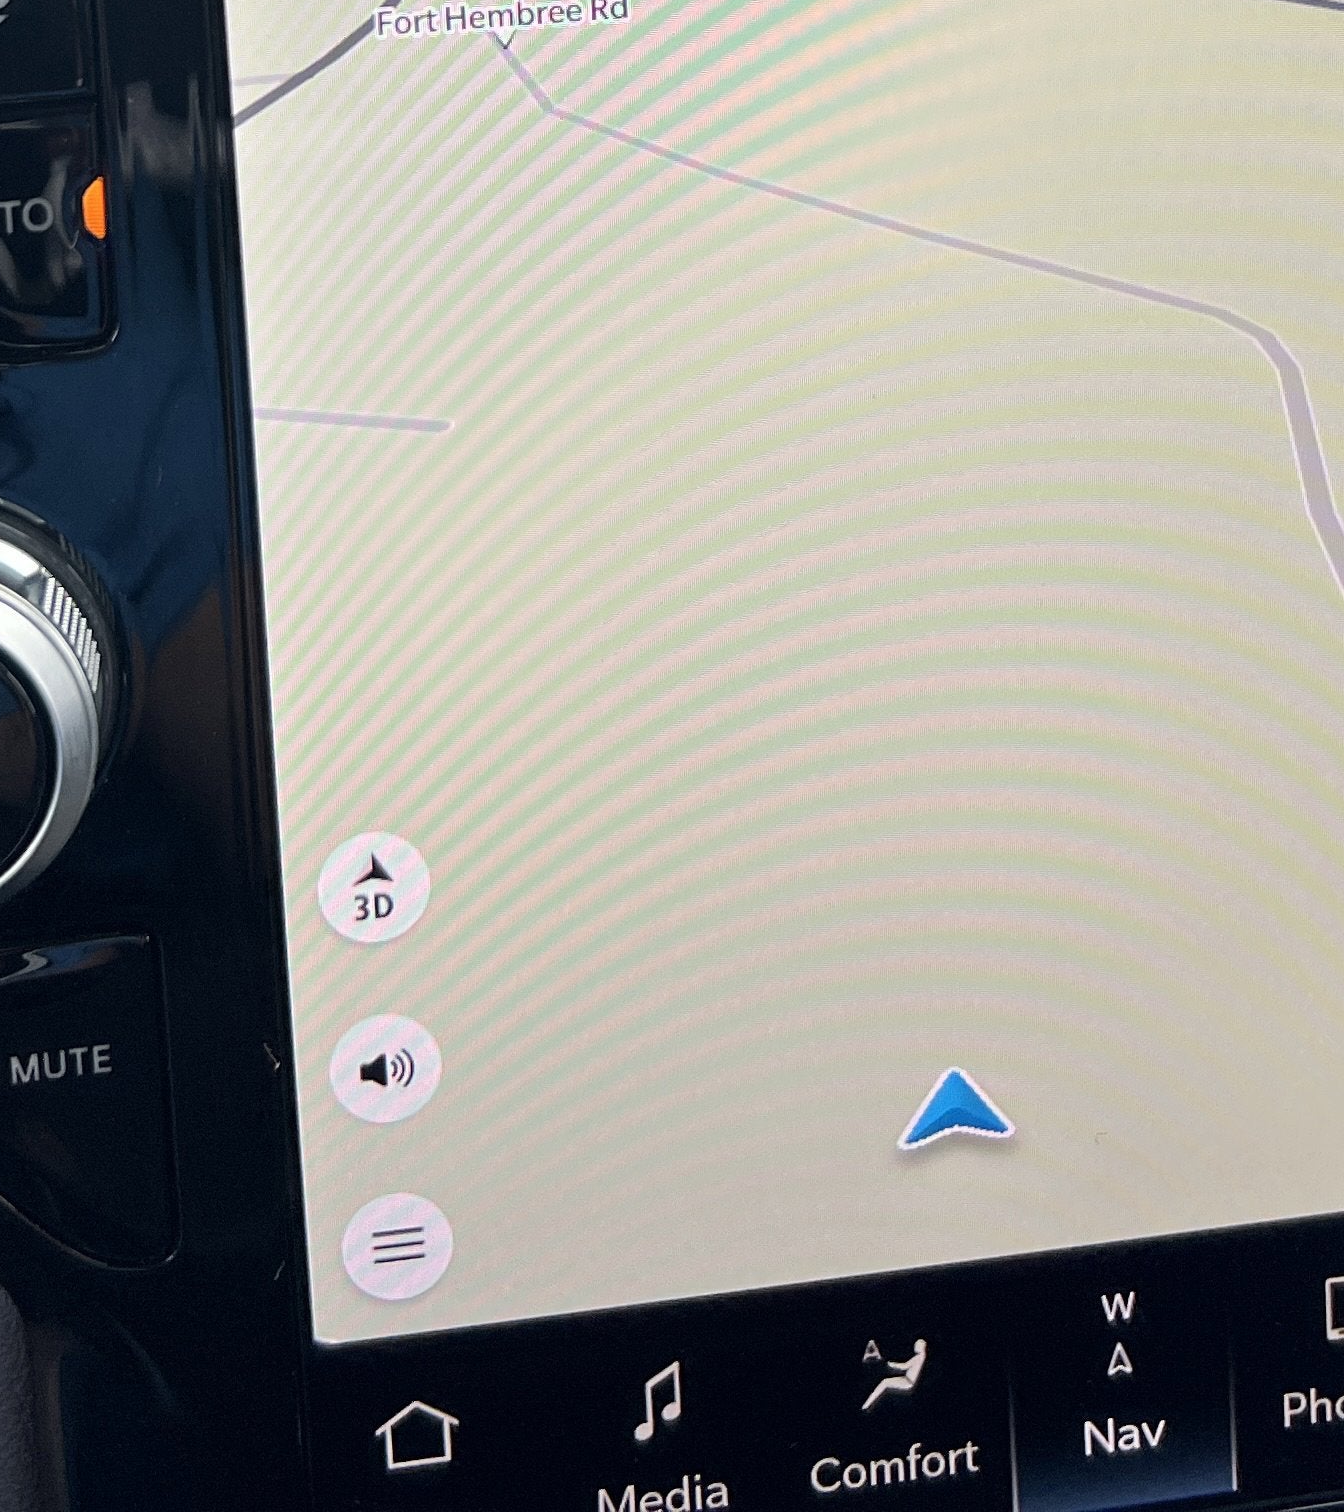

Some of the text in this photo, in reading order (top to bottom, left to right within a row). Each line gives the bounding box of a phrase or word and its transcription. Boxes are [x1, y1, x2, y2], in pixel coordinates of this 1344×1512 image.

[376, 9, 438, 37] Fort
[444, 0, 585, 32] Hembree
[353, 894, 394, 921] 3D
[9, 1042, 112, 1086] MUTE
[1101, 1291, 1136, 1323] W
[1083, 1417, 1167, 1456] Nav
[810, 1439, 980, 1493] Comfort
[597, 1474, 730, 1512] Media
